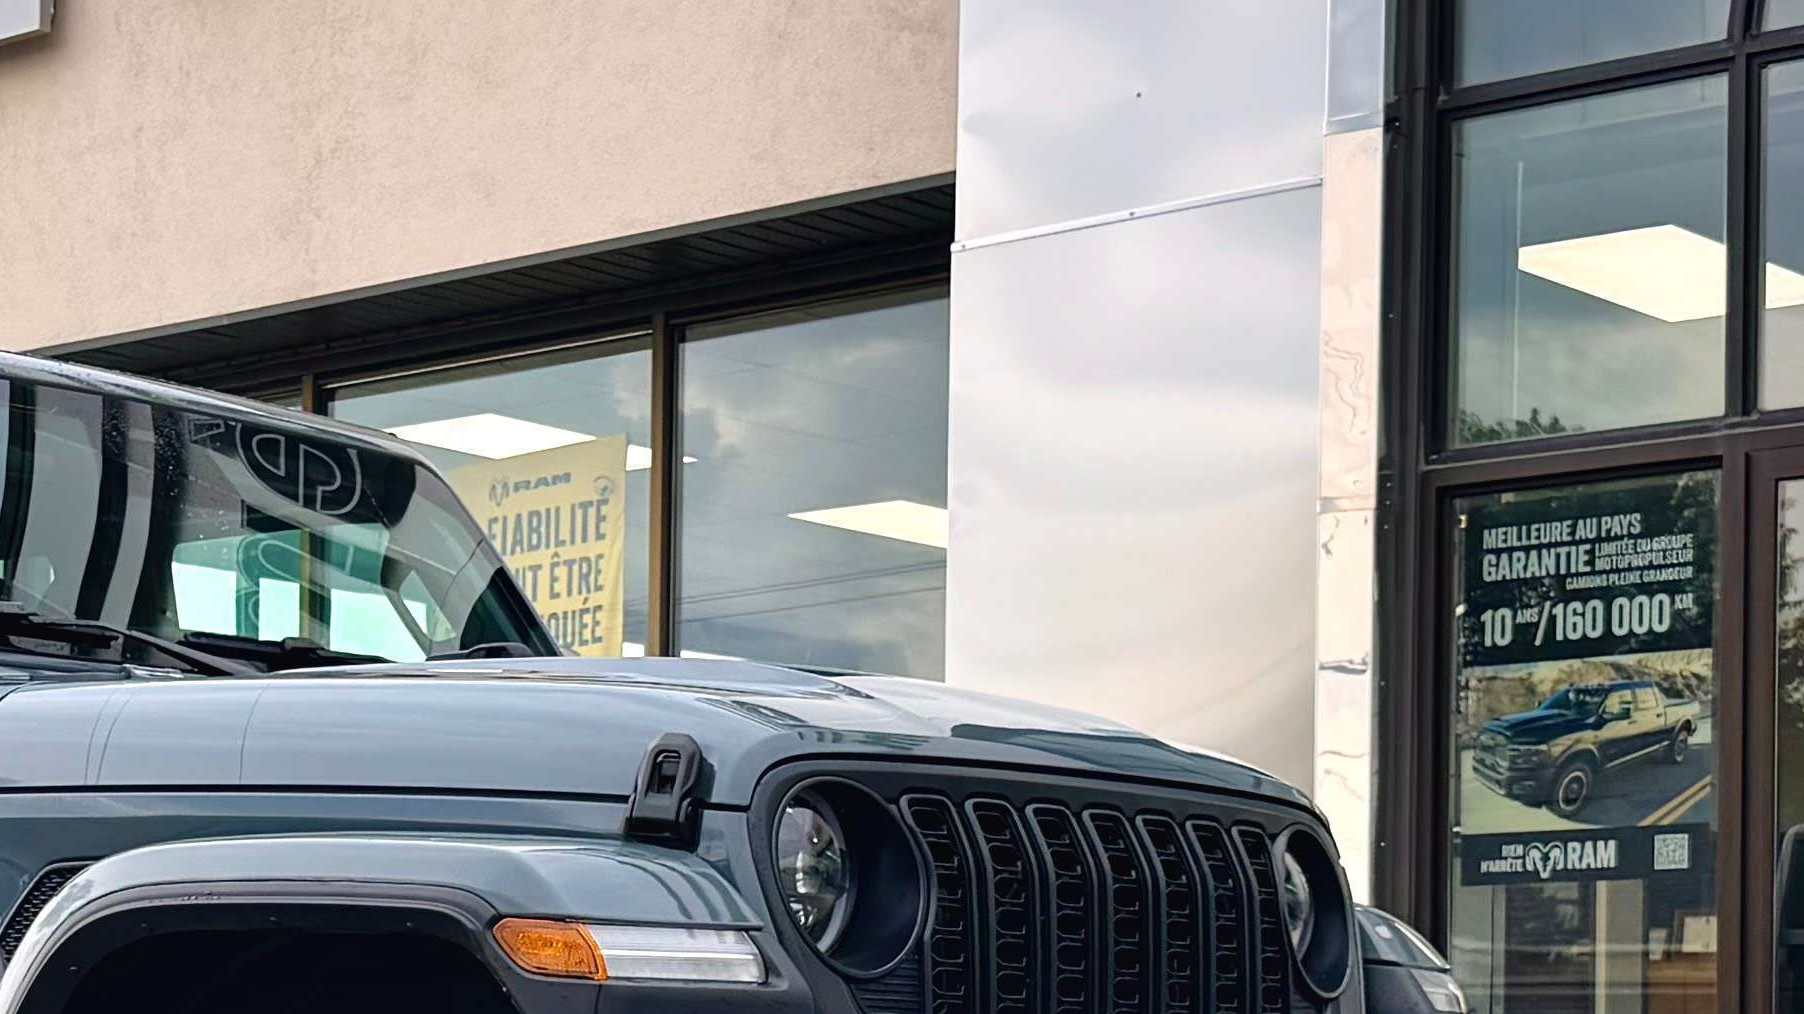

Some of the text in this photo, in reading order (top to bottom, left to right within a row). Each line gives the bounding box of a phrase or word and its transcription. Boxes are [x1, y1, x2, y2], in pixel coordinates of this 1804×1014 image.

[513, 472, 571, 492] RAM
[1482, 512, 1642, 549] MEILLEURE AU PAYS
[1595, 533, 1694, 556] LIMITÉE DU GROUPE
[1482, 544, 1591, 582] GARANTIE
[1594, 549, 1693, 571] MOTOPROPULSEUR
[1643, 566, 1693, 582] GRANDEUR
[550, 552, 604, 600] ÊTRE
[1481, 607, 1513, 647] 10
[1674, 593, 1694, 609] KM
[1567, 839, 1617, 870] RAM
